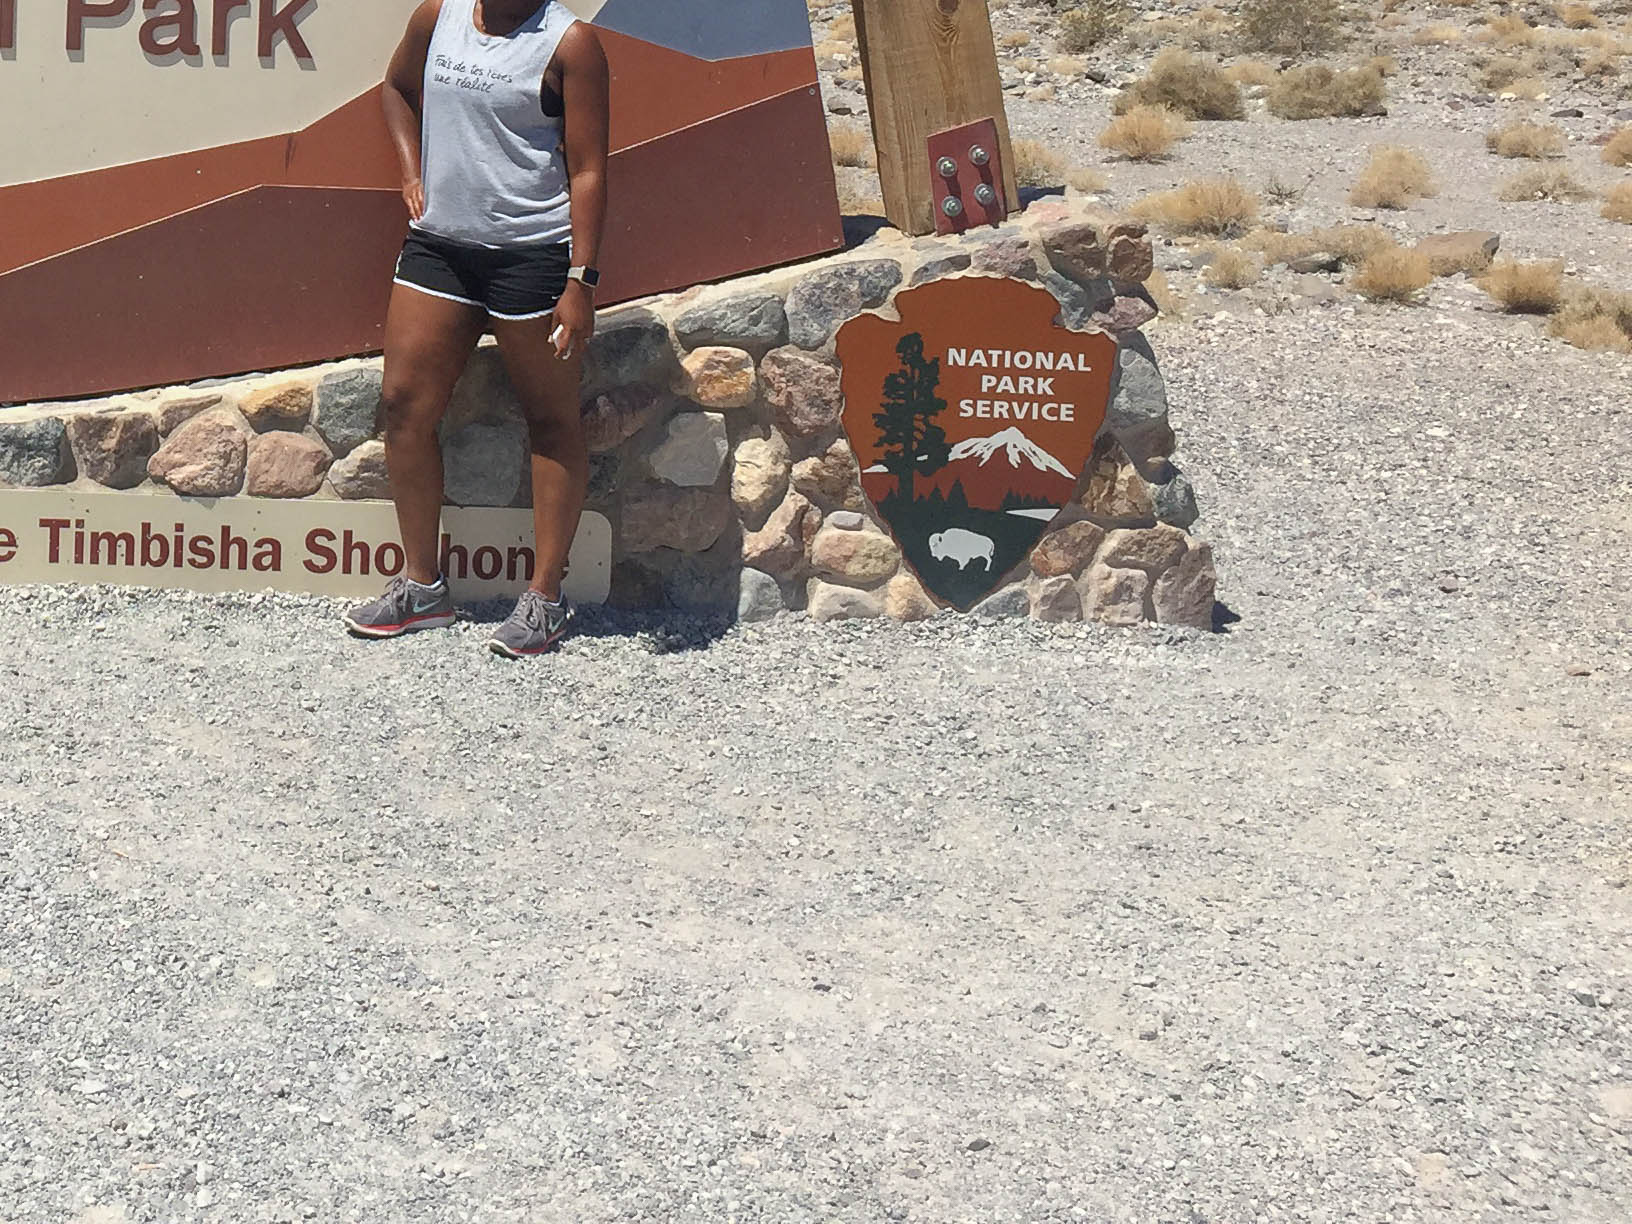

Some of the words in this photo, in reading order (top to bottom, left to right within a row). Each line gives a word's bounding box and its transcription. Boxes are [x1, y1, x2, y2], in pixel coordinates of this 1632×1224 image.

[946, 347, 1093, 373] NATIONAL
[980, 374, 1056, 396] PARK
[958, 399, 1076, 422] SERVICE
[38, 517, 283, 573] Timbisha
[302, 527, 569, 582] Shohon
